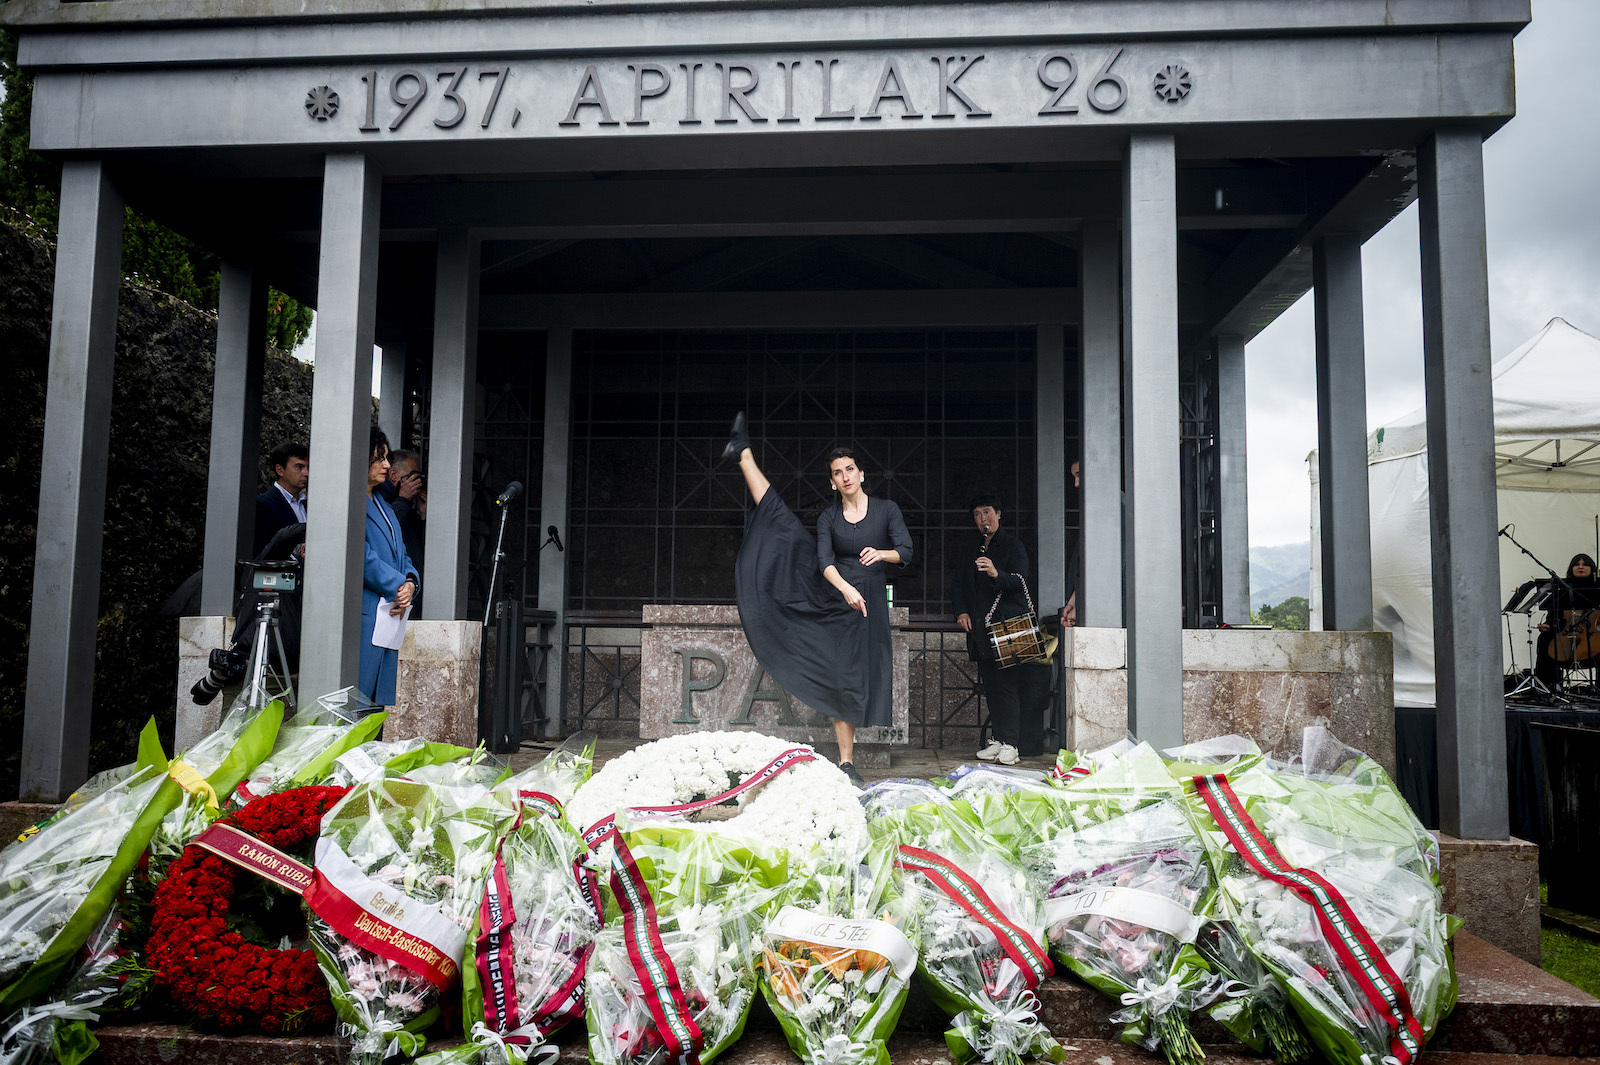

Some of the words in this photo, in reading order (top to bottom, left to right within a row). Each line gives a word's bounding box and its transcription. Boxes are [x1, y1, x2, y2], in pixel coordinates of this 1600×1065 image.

[557, 53, 993, 127] APIRILAK
[1036, 46, 1129, 116] 26
[672, 649, 836, 726] PA
[237, 843, 281, 870] RAMÓN
[354, 911, 441, 966] Deutsch-Baskischer
[1324, 898, 1381, 971] MUSEOA
